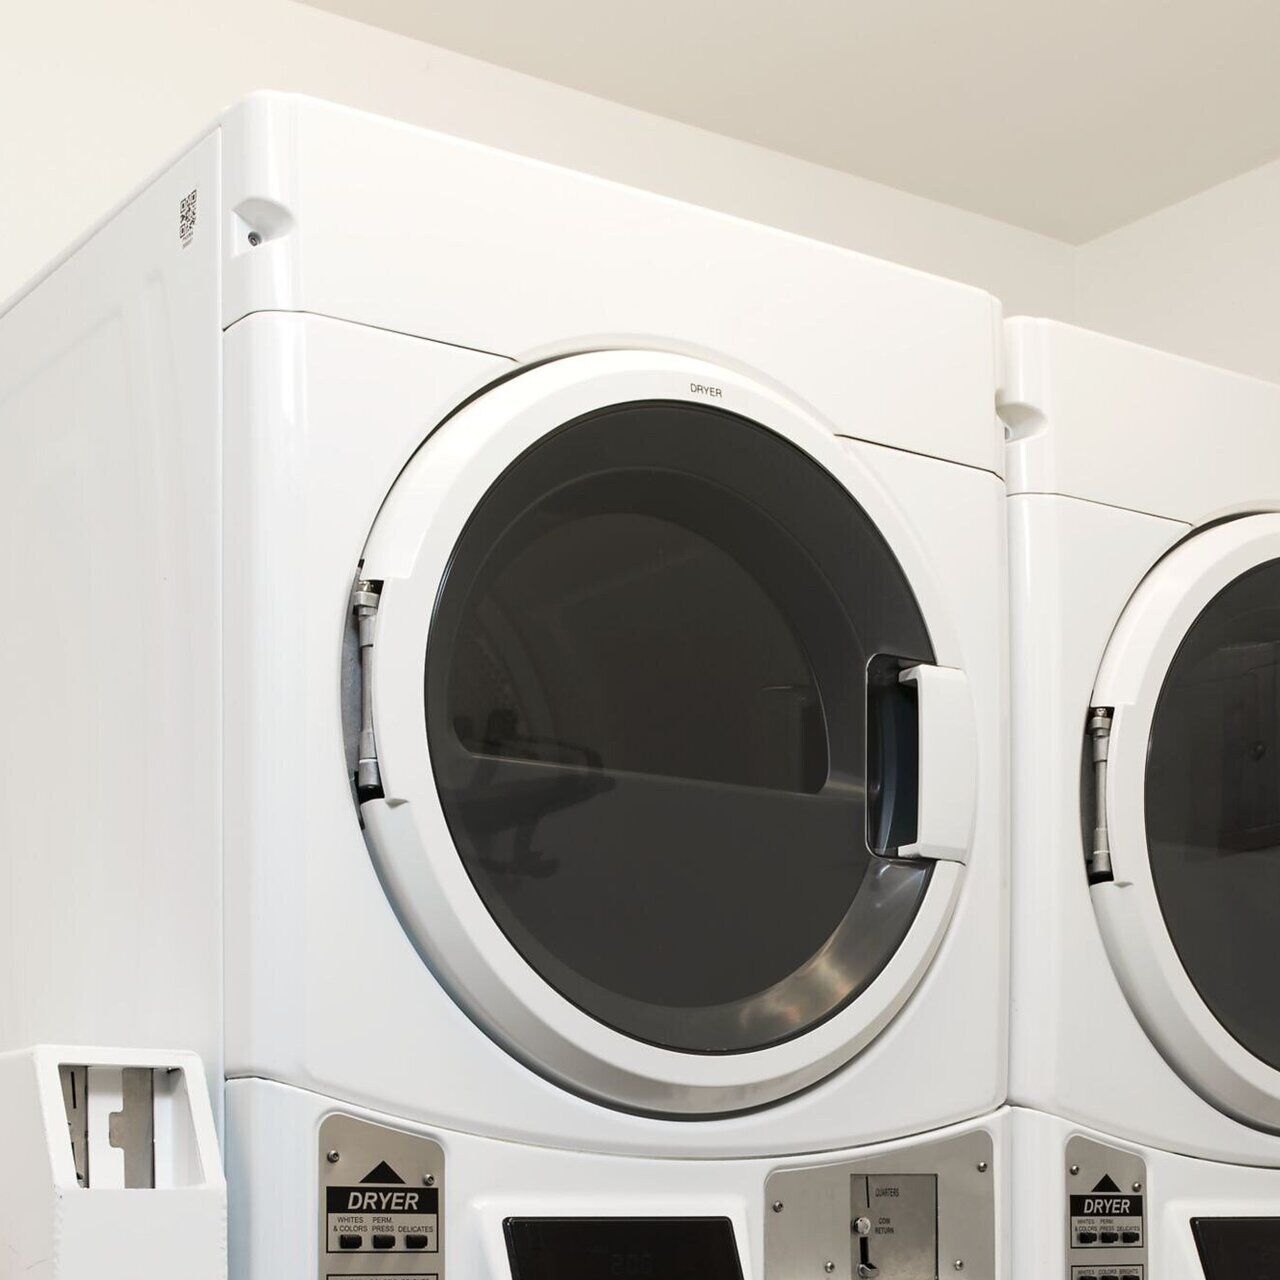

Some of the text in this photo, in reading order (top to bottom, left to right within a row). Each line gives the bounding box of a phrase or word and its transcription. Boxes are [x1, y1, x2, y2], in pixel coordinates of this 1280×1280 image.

[690, 383, 723, 398] DRYER
[347, 1192, 419, 1210] DRYER
[1084, 1199, 1130, 1214] DRYER
